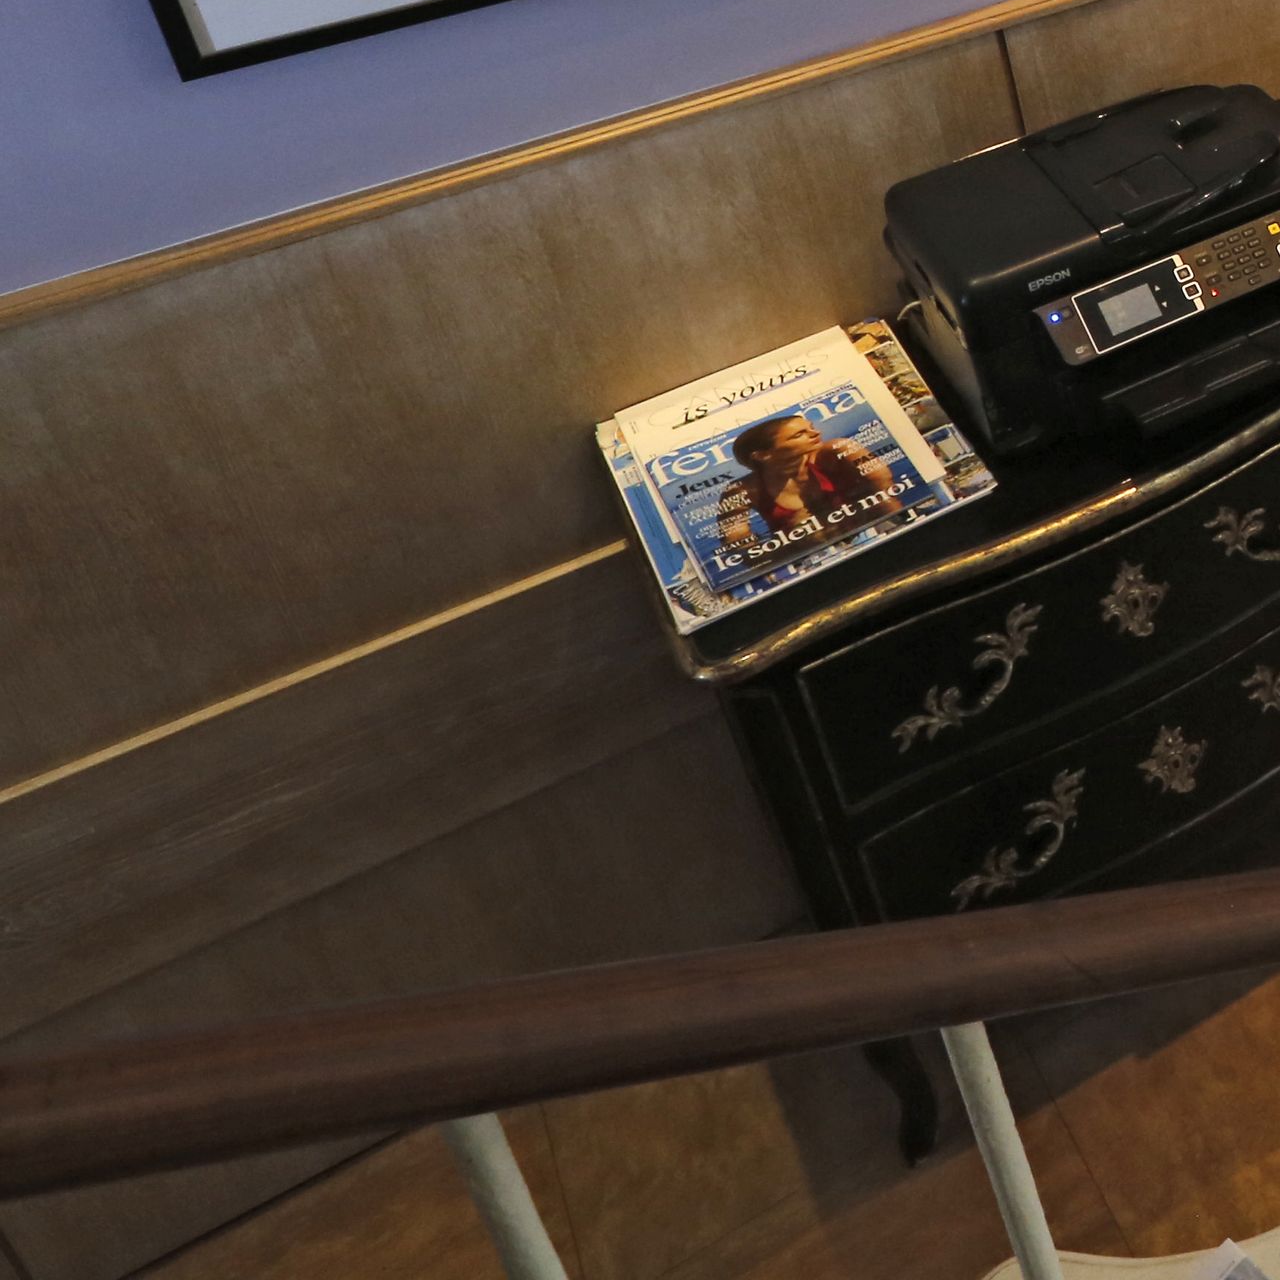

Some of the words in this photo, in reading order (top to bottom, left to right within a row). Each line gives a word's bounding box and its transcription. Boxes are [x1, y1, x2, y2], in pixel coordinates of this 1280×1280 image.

[1028, 268, 1071, 293] EPSON
[681, 402, 709, 425] is
[720, 364, 808, 407] yours
[676, 470, 736, 499] Jeux
[711, 553, 745, 572] le
[747, 515, 826, 560] soleil
[827, 502, 858, 524] et
[858, 473, 916, 511] moi
